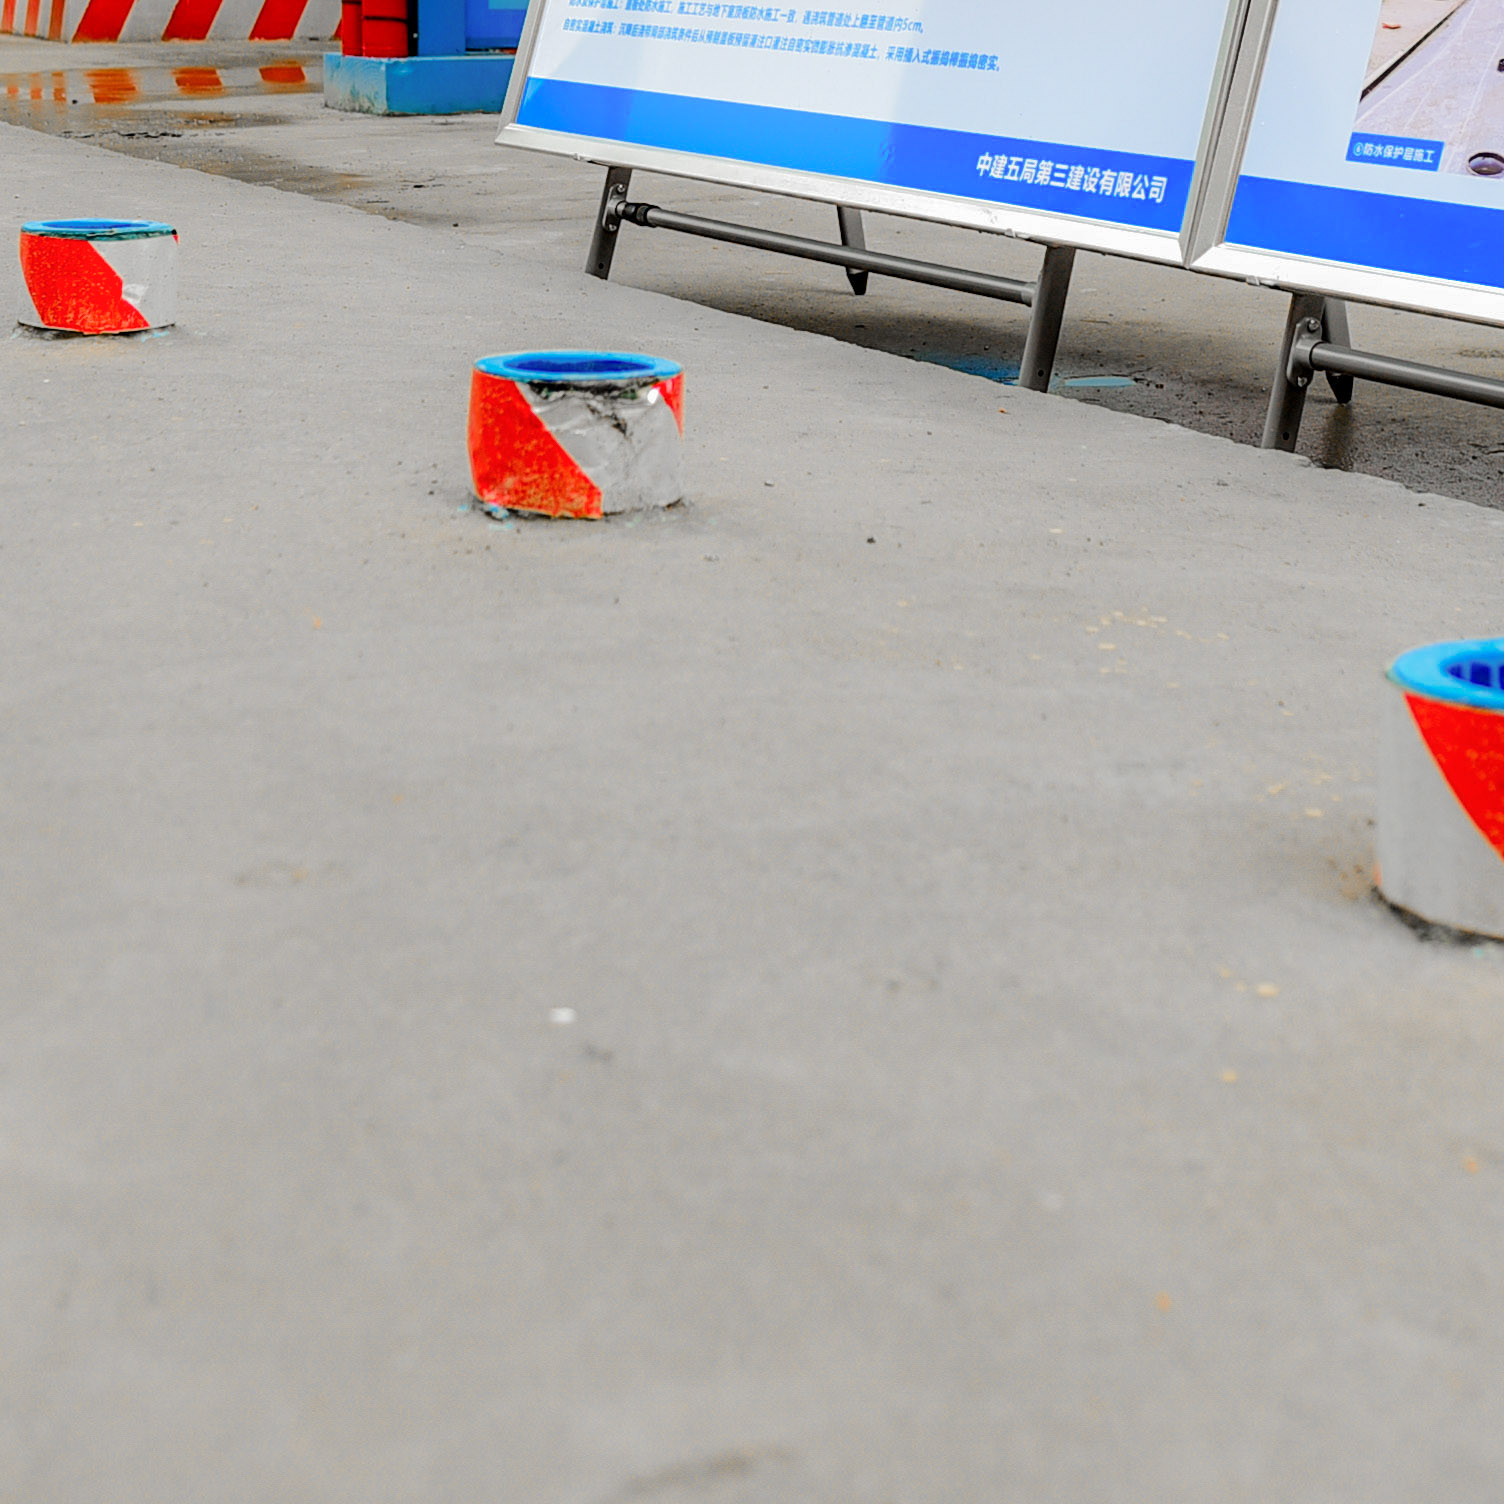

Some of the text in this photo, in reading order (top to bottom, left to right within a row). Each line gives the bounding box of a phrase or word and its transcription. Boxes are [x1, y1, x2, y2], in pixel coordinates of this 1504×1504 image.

[975, 153, 1167, 204] 中建五局第三建设有限公司
